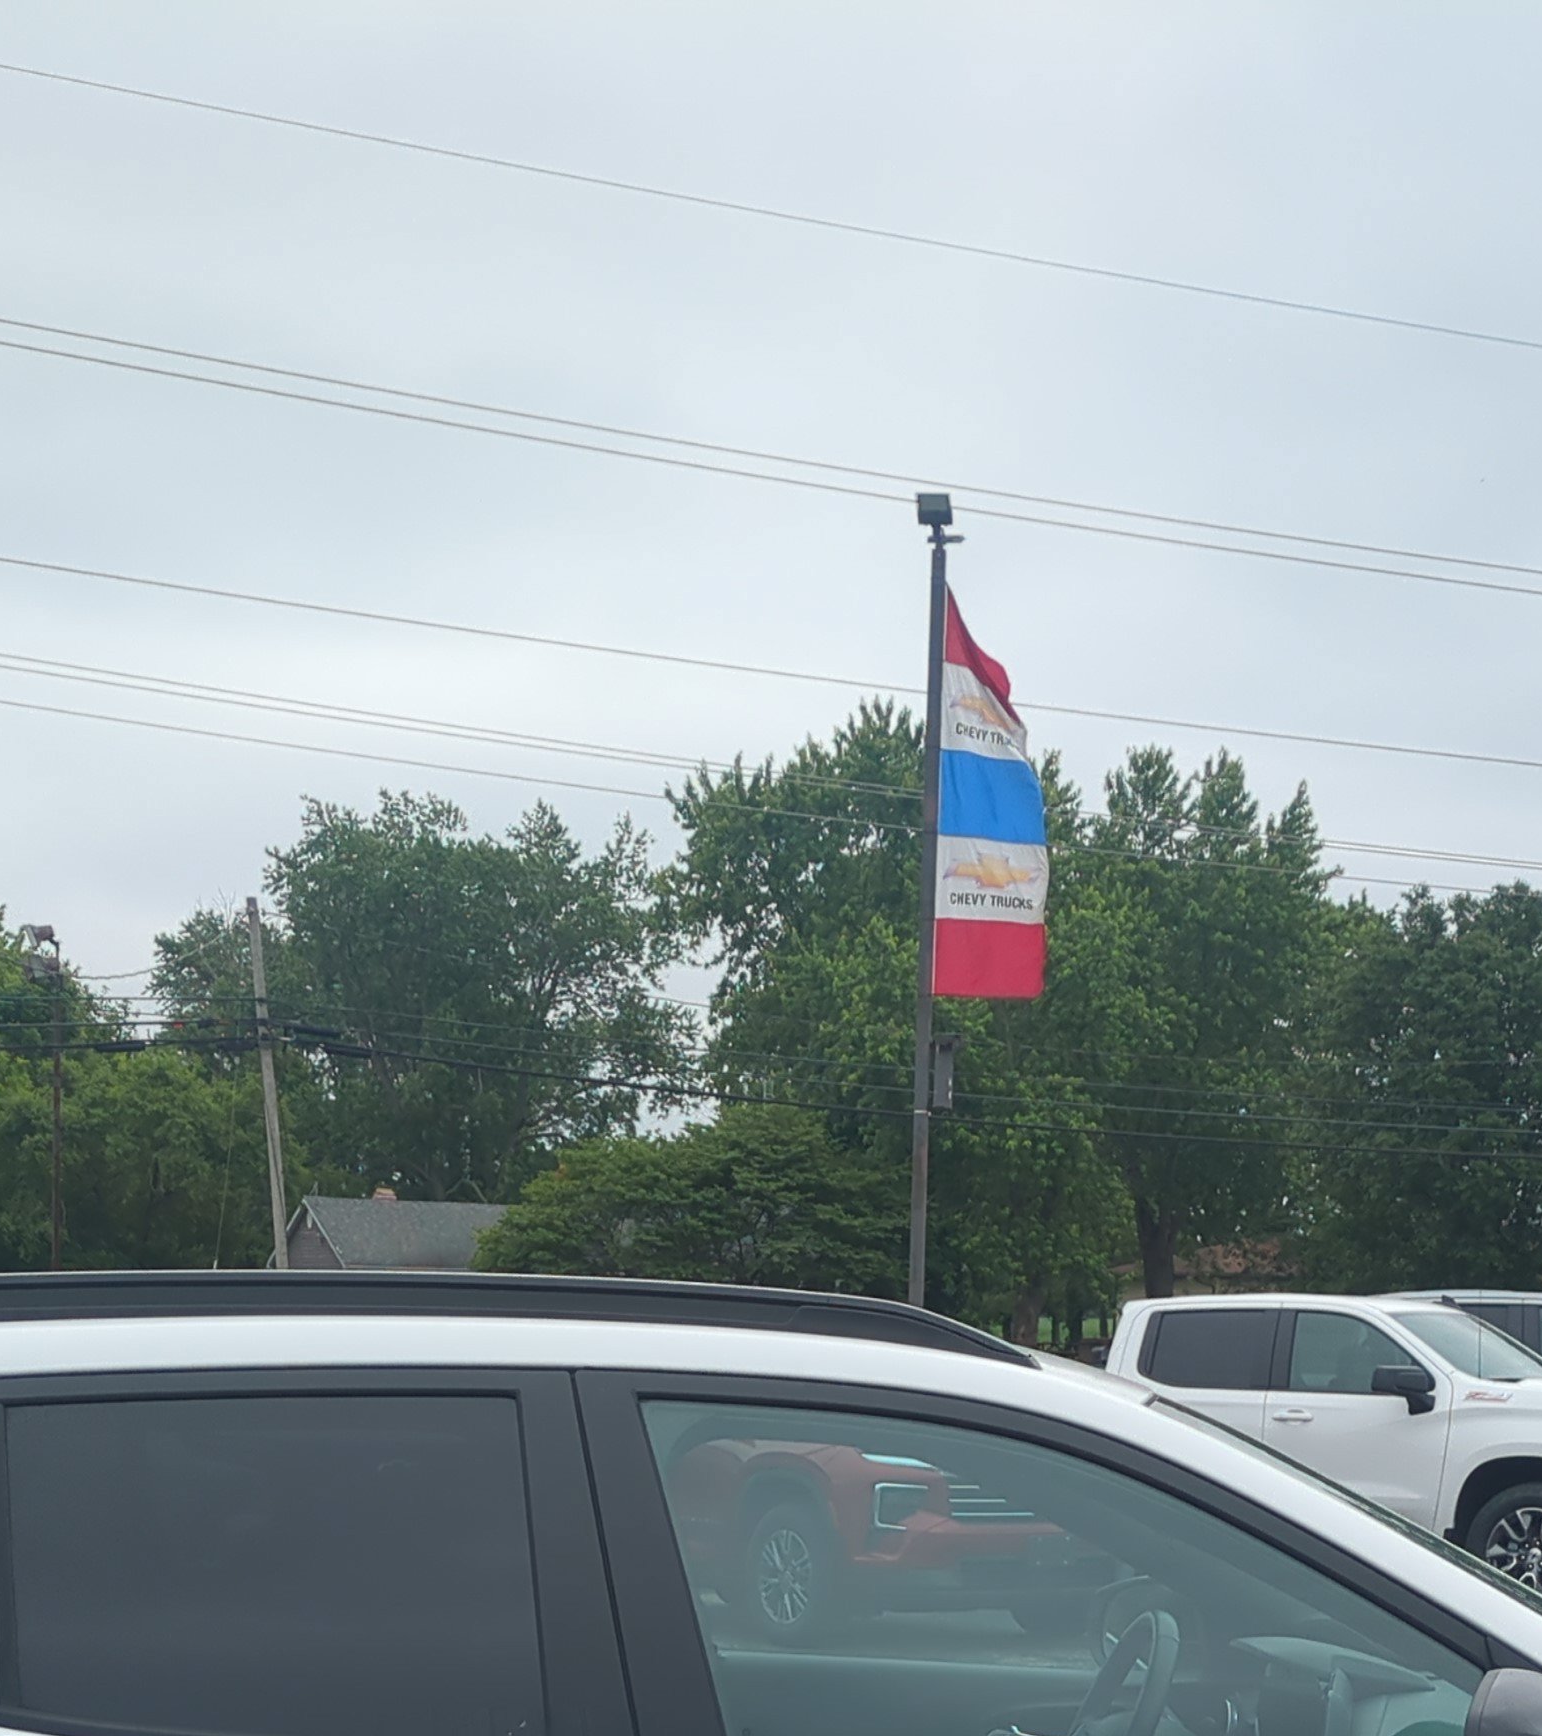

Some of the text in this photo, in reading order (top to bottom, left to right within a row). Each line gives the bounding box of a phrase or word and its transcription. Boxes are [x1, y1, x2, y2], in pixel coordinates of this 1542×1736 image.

[955, 722, 988, 741] CHEVY
[949, 892, 1033, 910] CHEVY TRUCKS
